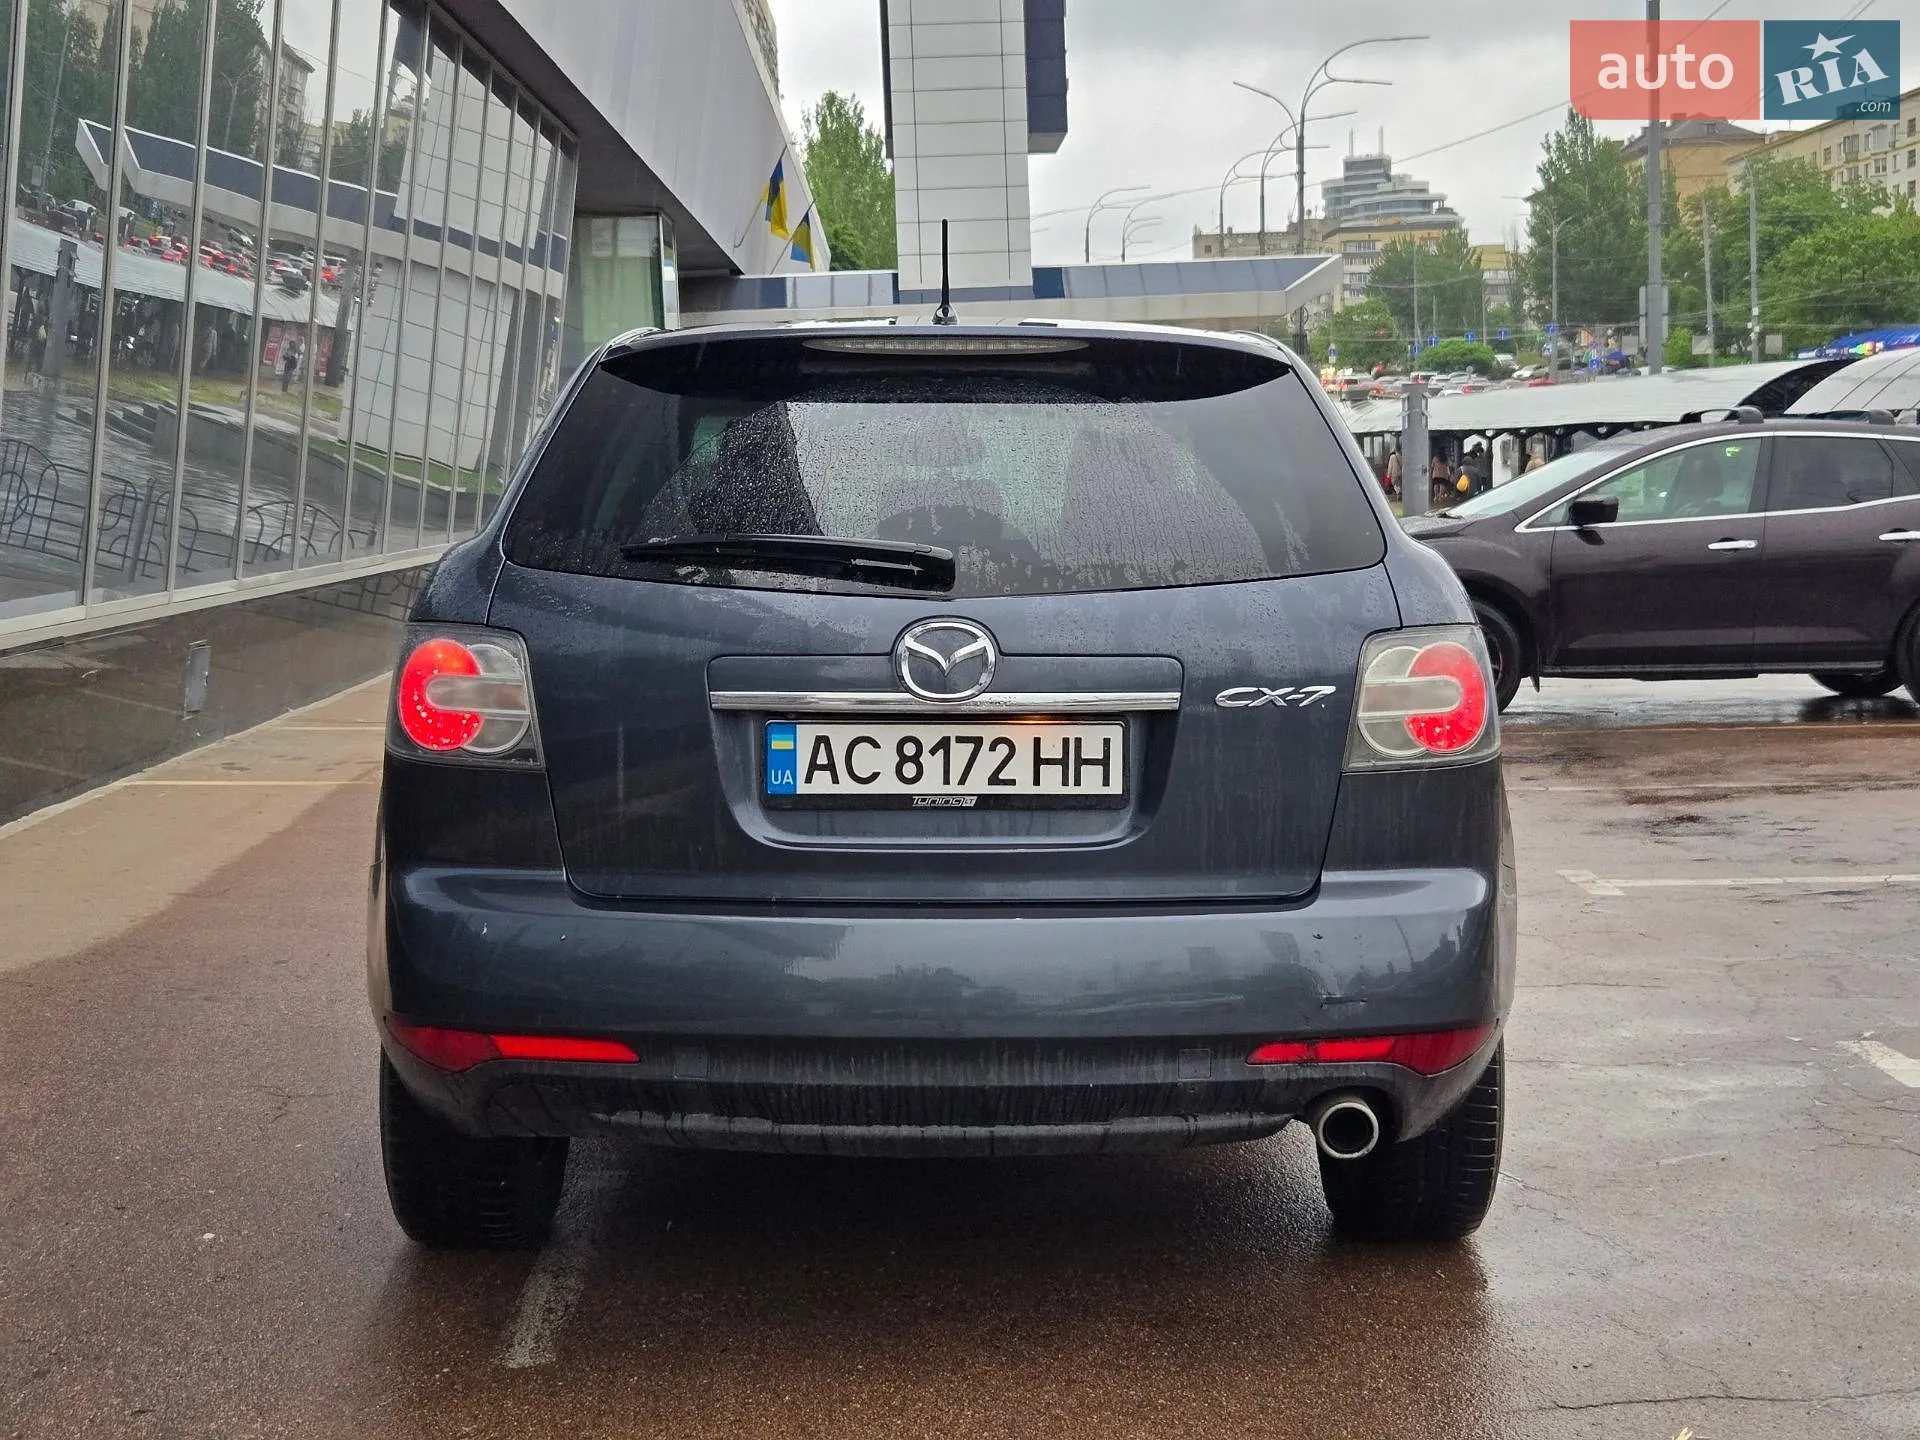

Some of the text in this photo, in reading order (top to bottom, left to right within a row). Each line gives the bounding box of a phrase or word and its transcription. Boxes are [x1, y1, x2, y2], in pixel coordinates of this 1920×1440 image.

[1215, 685, 1337, 708] CX-7
[804, 735, 1112, 787] AC 8172 HH
[771, 768, 794, 785] UA
